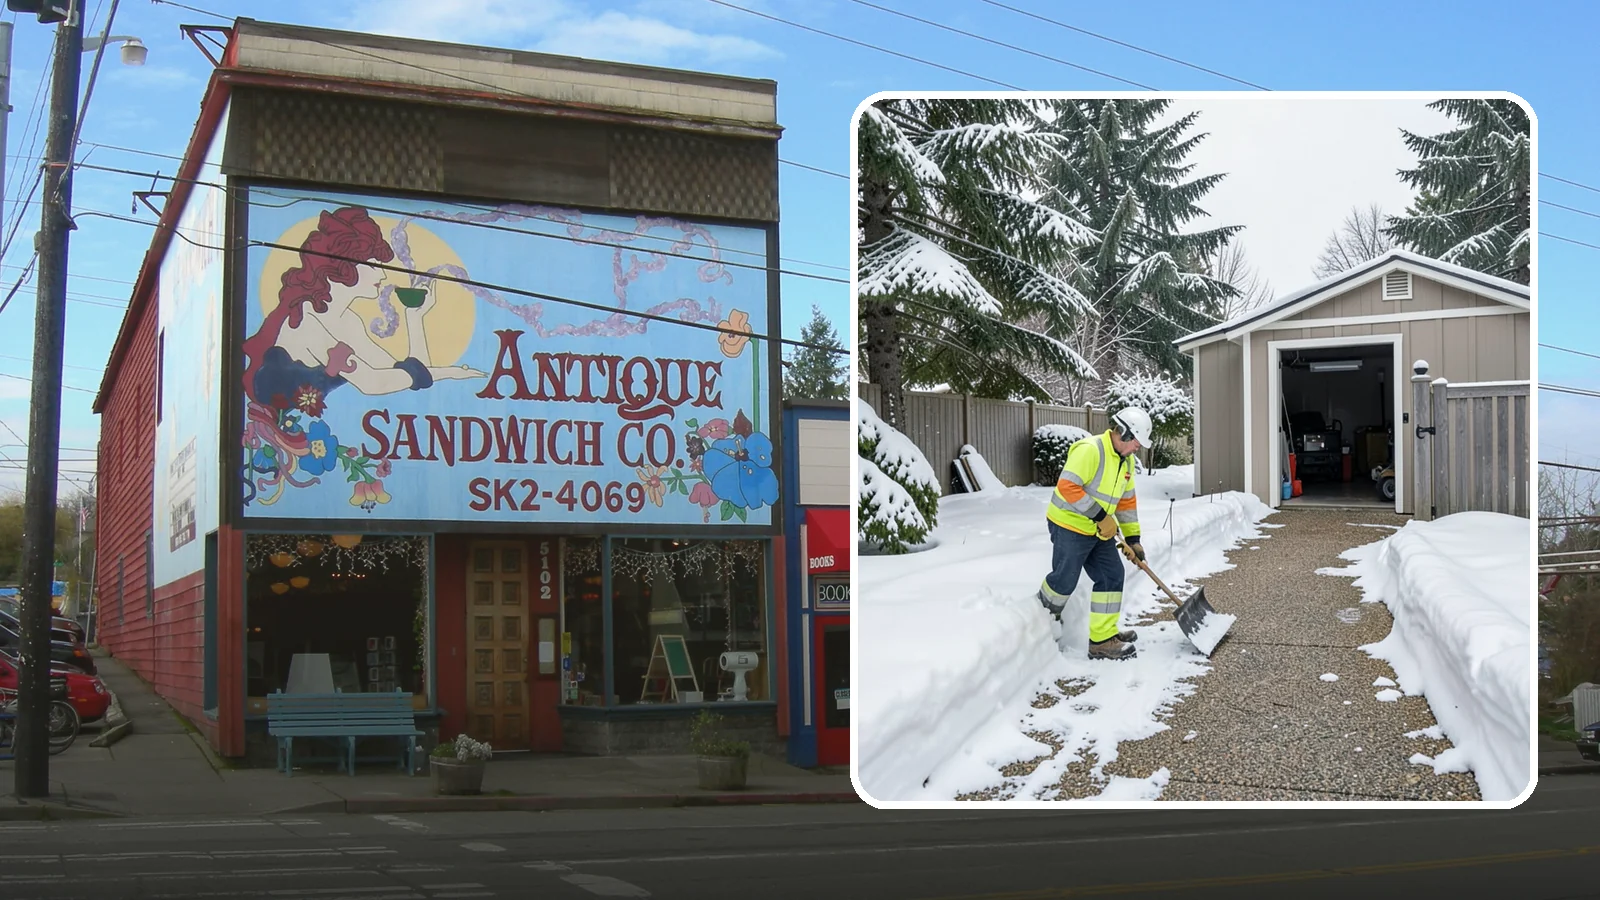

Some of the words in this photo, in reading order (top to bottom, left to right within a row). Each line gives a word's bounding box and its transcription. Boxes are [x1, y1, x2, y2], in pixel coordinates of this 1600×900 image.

[476, 329, 723, 421] ANTIQUE
[361, 408, 604, 467] SANDWICH
[617, 421, 685, 469] CO.
[468, 477, 646, 513] SK2-4069
[539, 542, 552, 600] 5102
[809, 555, 834, 569] BOOKS
